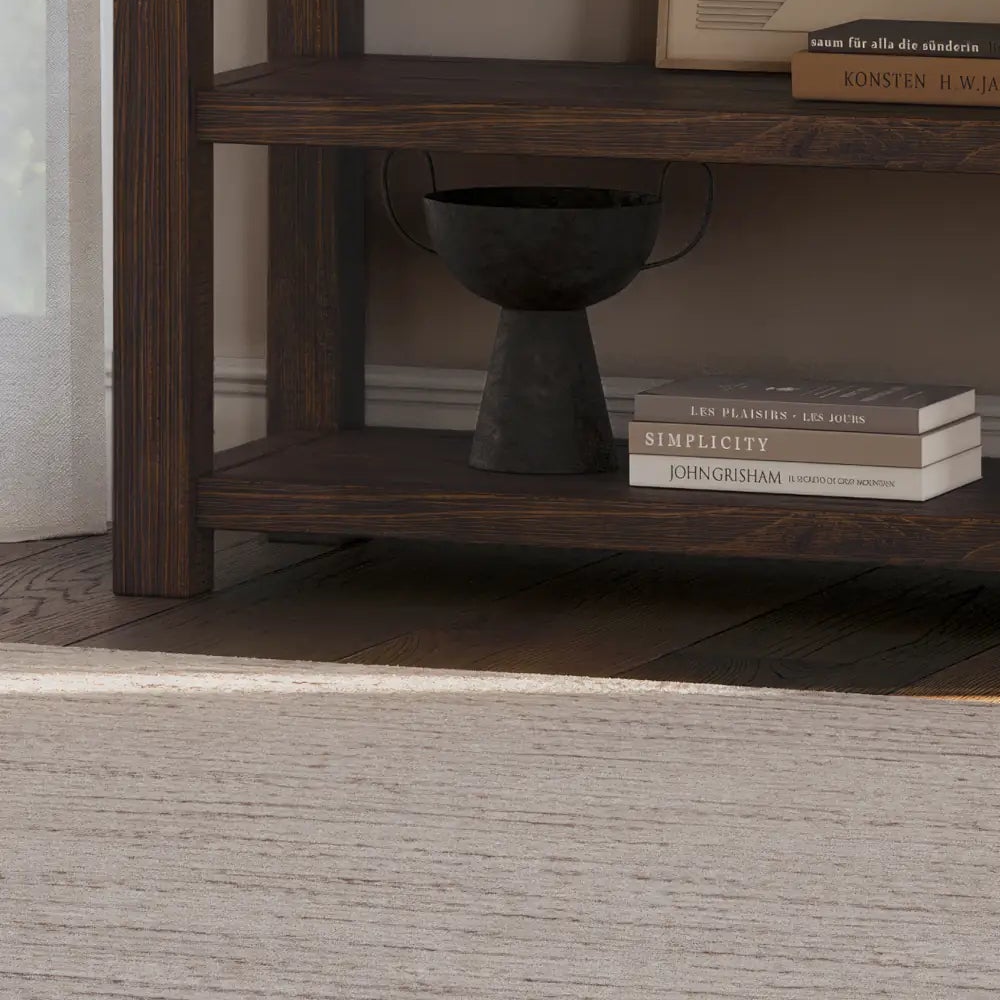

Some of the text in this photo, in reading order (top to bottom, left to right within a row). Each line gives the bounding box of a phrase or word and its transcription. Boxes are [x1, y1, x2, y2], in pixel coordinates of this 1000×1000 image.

[811, 38, 843, 48] saum
[849, 36, 867, 48] für
[871, 38, 894, 49] alla
[899, 38, 917, 50] die
[922, 40, 979, 52] sünderin
[844, 71, 925, 89] KONSTEN
[691, 405, 866, 424] LES PLAISIRS LES JOURS
[645, 432, 769, 452] SIMPLICITY
